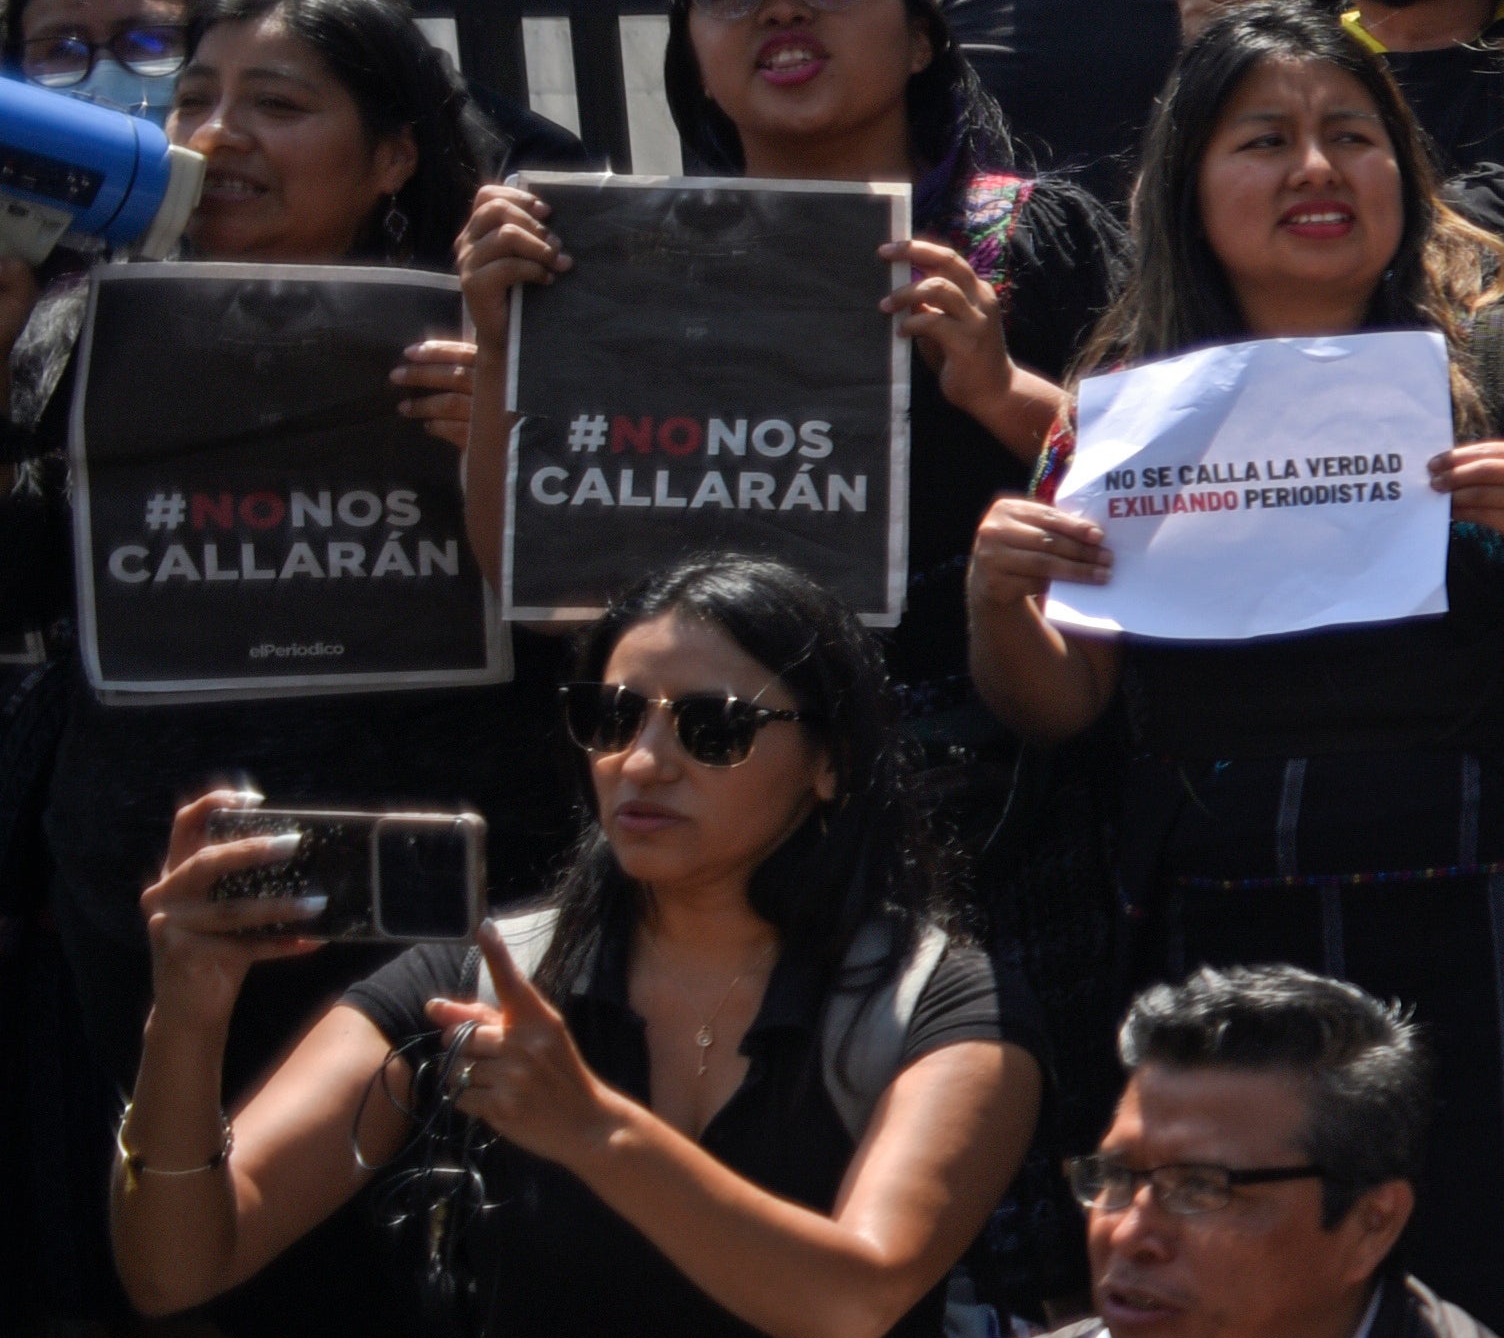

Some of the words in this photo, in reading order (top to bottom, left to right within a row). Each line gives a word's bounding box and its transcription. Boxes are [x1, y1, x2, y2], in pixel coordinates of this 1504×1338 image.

[568, 414, 833, 458] #NONOS
[530, 462, 868, 512] CALLARÁN
[1105, 468, 1136, 493] NO
[1143, 465, 1172, 489] SE
[1178, 459, 1261, 486] CALLA
[1266, 457, 1298, 479] LA
[1305, 451, 1403, 477] VERDAD
[145, 489, 421, 531] #NONOS
[1107, 489, 1238, 520] EXILIANDO
[1243, 480, 1402, 511] PERIODISTAS
[108, 531, 459, 584] CALLARÁN
[249, 641, 345, 659] elPeriodico
